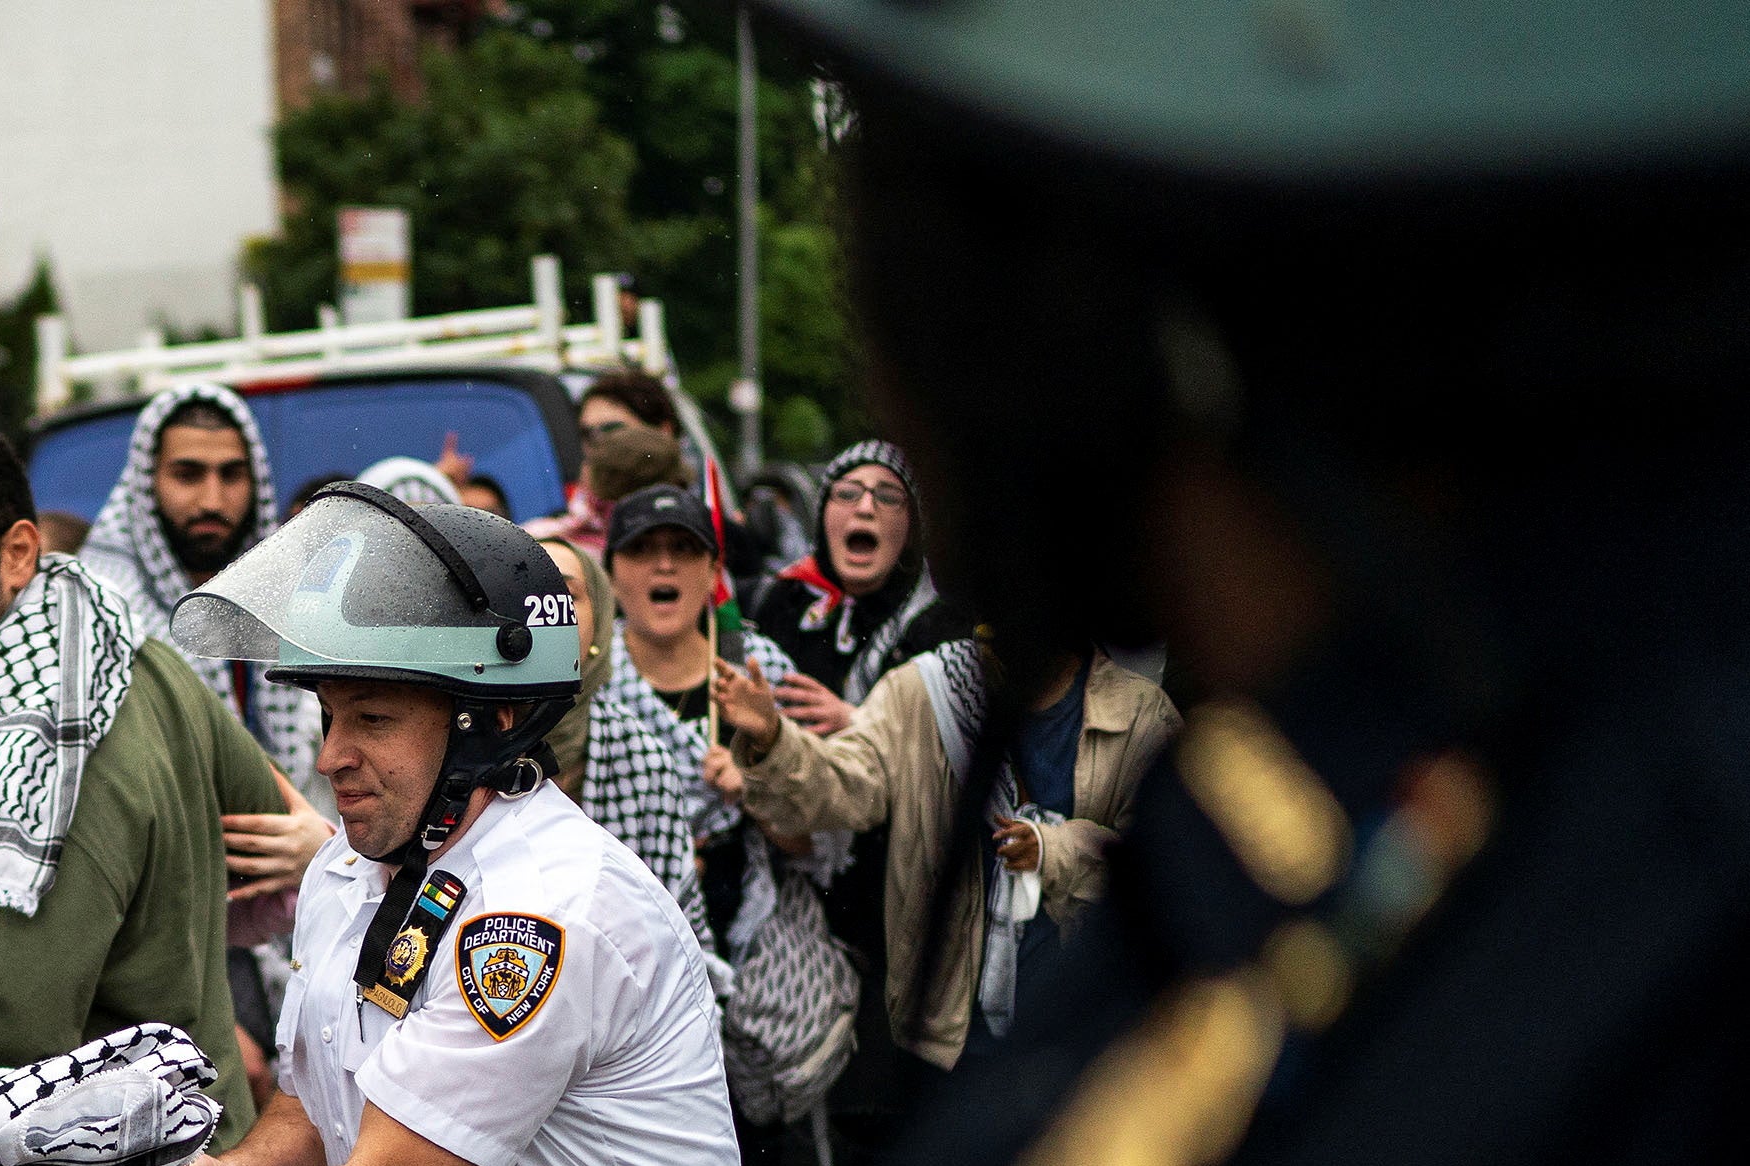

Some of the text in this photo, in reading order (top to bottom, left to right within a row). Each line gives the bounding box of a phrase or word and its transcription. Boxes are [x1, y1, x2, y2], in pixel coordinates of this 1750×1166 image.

[524, 594, 577, 626] 2975
[484, 917, 537, 934] POLICE
[463, 929, 556, 955] DEPARTMENT
[461, 966, 490, 1014] CITY OF
[506, 964, 555, 1025] NEW YORK
